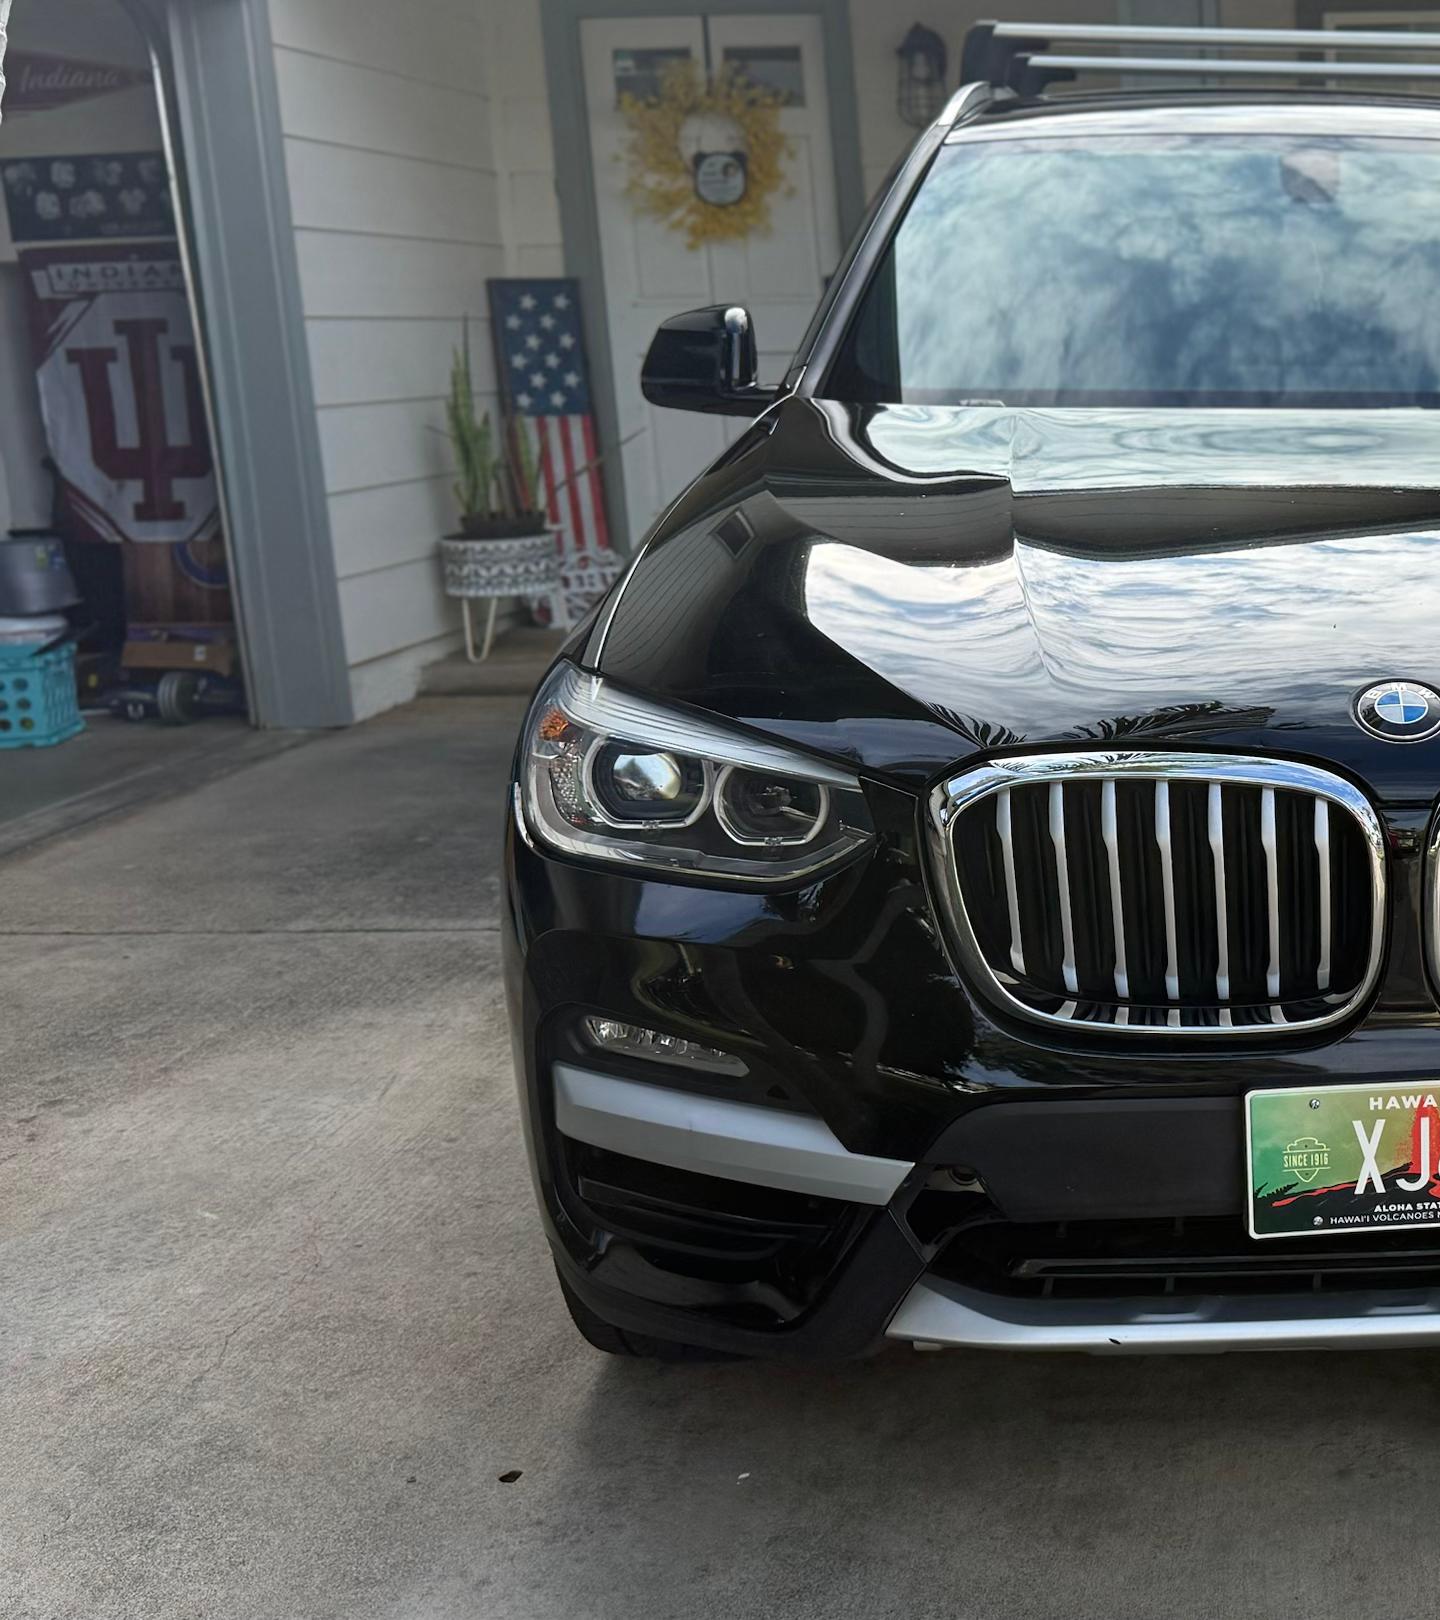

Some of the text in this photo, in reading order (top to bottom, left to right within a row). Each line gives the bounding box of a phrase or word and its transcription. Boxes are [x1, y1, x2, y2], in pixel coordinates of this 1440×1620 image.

[20, 64, 118, 93] Indiana
[1283, 1152, 1329, 1168] SINCE 1916
[1374, 1203, 1414, 1213] ALOHA
[1373, 1210, 1434, 1222] VOLCANOES
